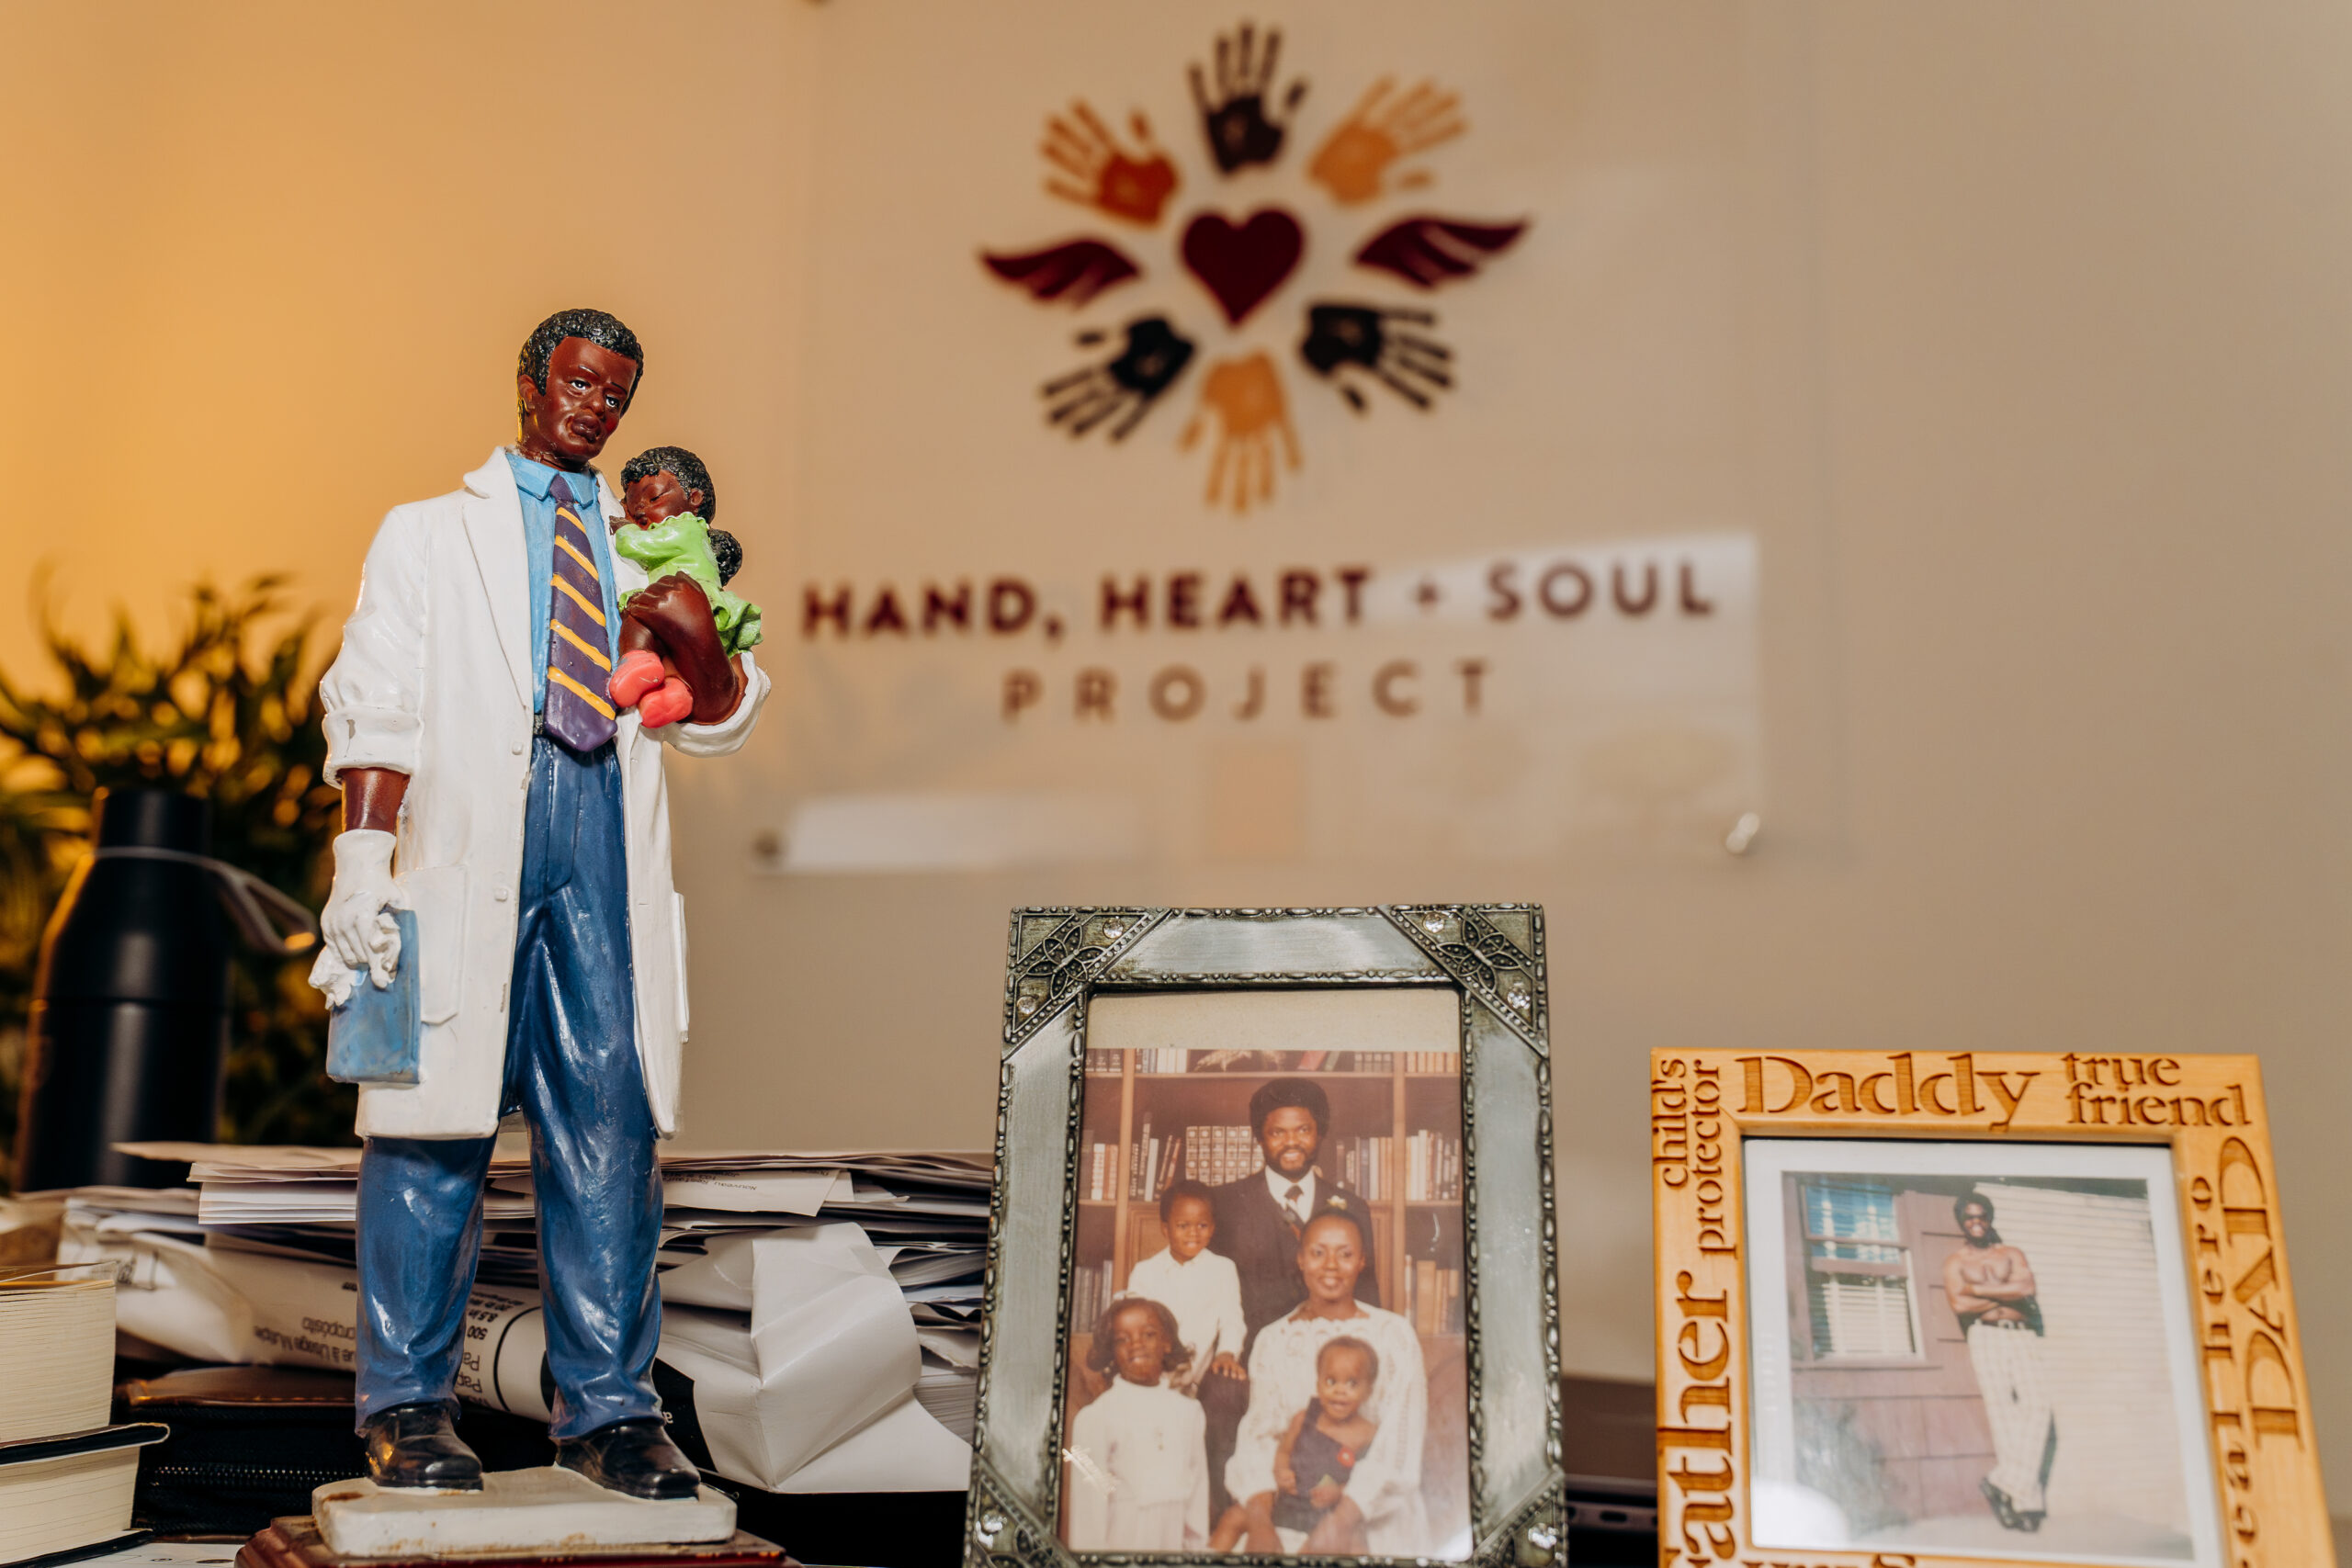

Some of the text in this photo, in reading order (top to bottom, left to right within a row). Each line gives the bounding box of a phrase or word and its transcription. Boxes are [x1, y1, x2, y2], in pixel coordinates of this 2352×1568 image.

[801, 576, 1064, 645] HAND,
[1101, 564, 1372, 632] HEART
[1486, 560, 1715, 621] SOUL
[1001, 656, 1490, 724] PROJECT
[1735, 1053, 2041, 1134] Daddy
[2061, 1053, 2181, 1088] true
[2065, 1083, 2252, 1128] friend
[1653, 1056, 1687, 1189] child's
[1692, 1059, 1737, 1259] protector
[467, 1325, 488, 1340] 500
[2218, 1136, 2305, 1453] DAD
[2190, 1176, 2260, 1568] eal hero
